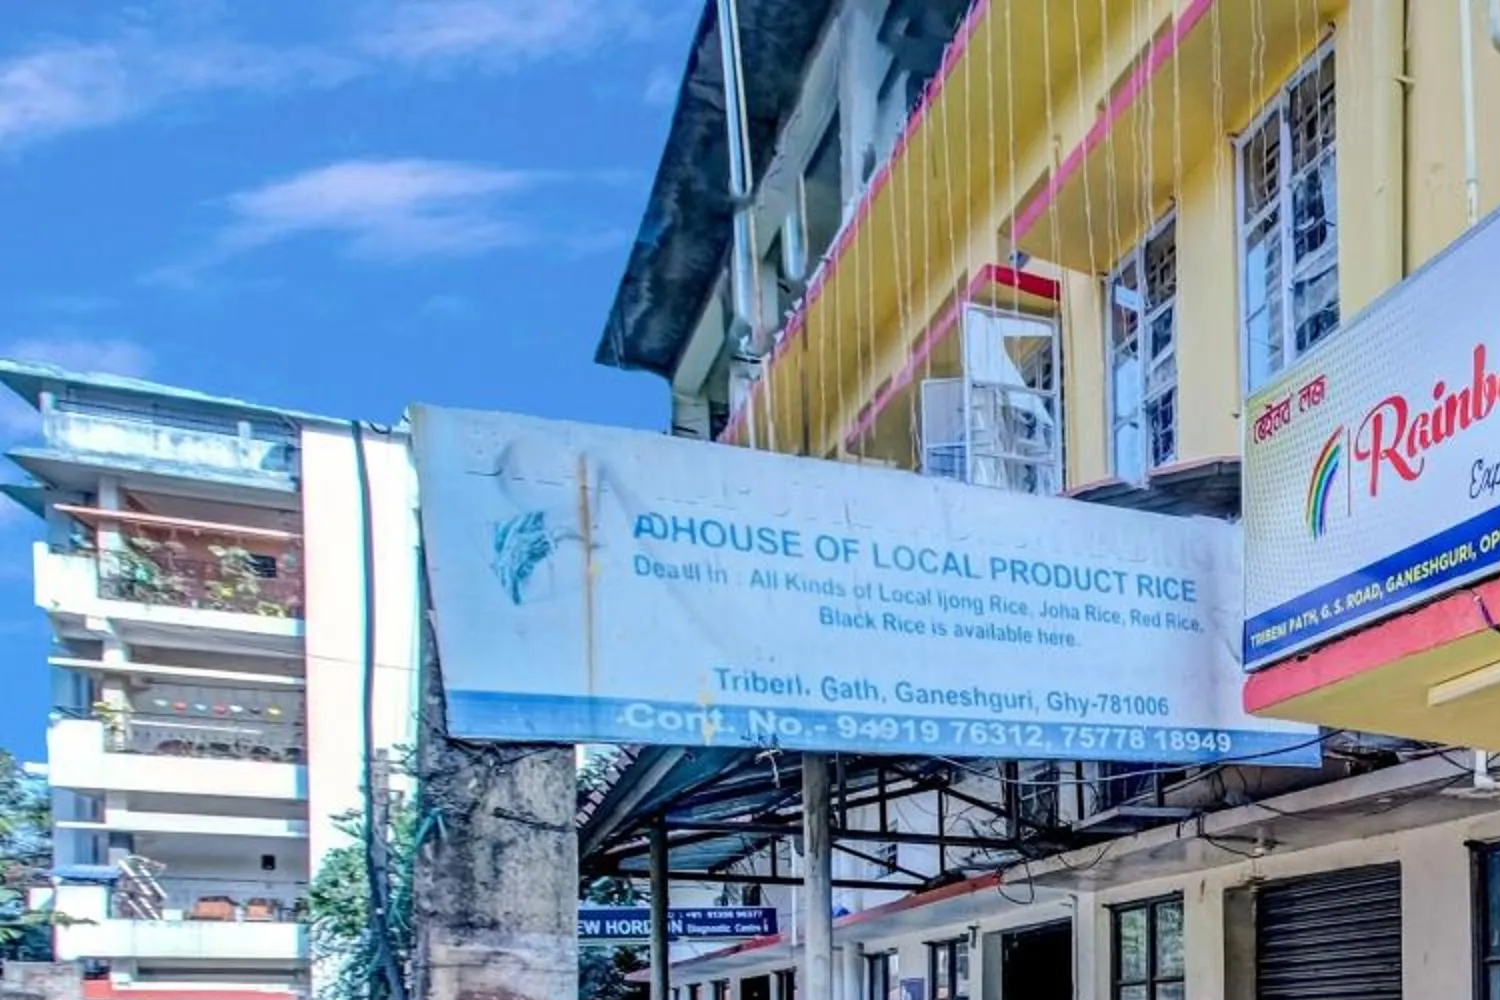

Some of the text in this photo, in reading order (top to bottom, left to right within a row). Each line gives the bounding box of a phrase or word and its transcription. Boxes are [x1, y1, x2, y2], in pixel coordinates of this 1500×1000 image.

[815, 534, 861, 563] OF
[872, 541, 982, 579] LOCAL
[990, 556, 1128, 595] PRODUCT
[1136, 573, 1199, 603] RICE
[1345, 582, 1384, 610] ROAD,
[1385, 544, 1478, 592] GANESHGURI,
[750, 568, 779, 590] All
[785, 572, 846, 598] Kinds
[852, 578, 872, 600] of
[878, 581, 932, 606] Local
[1130, 608, 1161, 630] Red
[818, 606, 874, 632] Black
[880, 611, 926, 635] Rice
[931, 620, 948, 637] is
[953, 622, 1033, 644] available
[895, 681, 1041, 714] Ganeshguri,
[1047, 691, 1170, 718] Ghy-781006
[1062, 725, 1146, 750] 75778
[1154, 730, 1232, 753] 18949
[577, 919, 601, 935] EW
